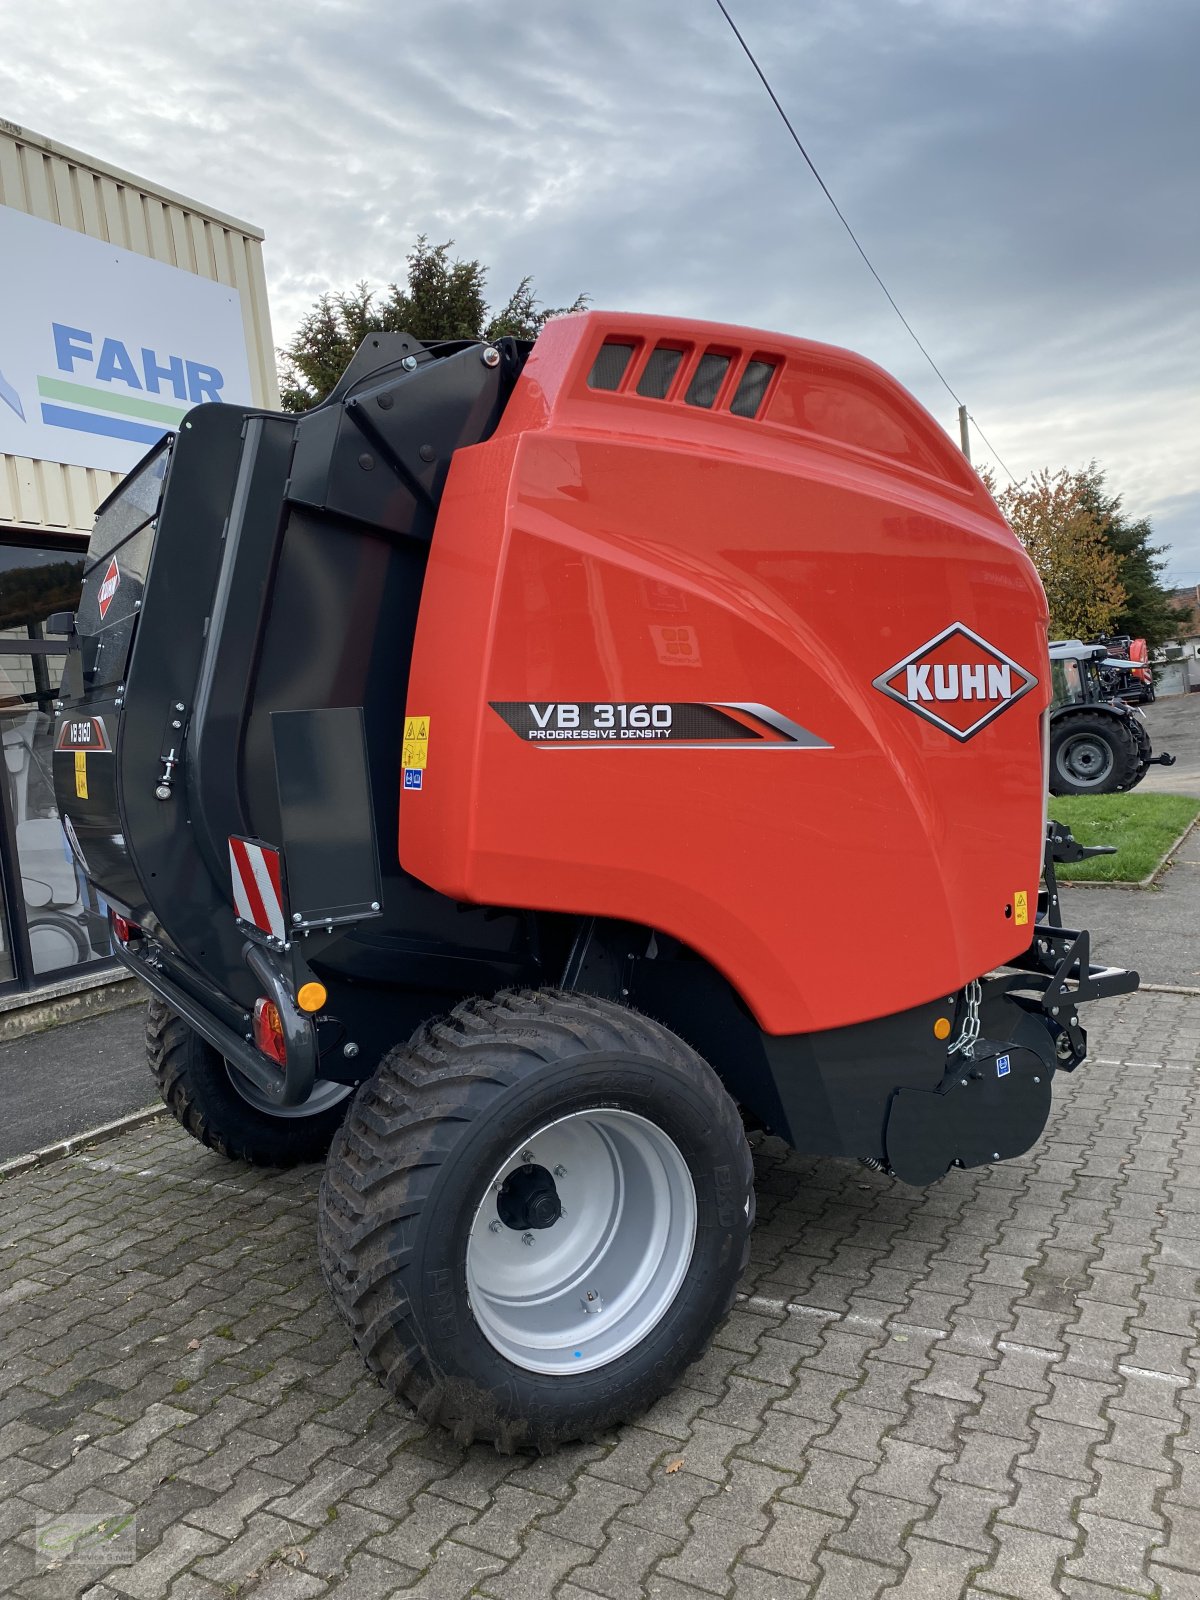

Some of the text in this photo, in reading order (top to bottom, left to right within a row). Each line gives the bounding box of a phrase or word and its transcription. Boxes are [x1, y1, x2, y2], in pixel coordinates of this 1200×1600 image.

[52, 322, 225, 404] FAHR
[907, 665, 1011, 701] KUHN
[528, 704, 673, 728] VB 3160
[78, 722, 91, 742] 3160
[528, 729, 672, 739] PROGRESSIVE DENSITY
